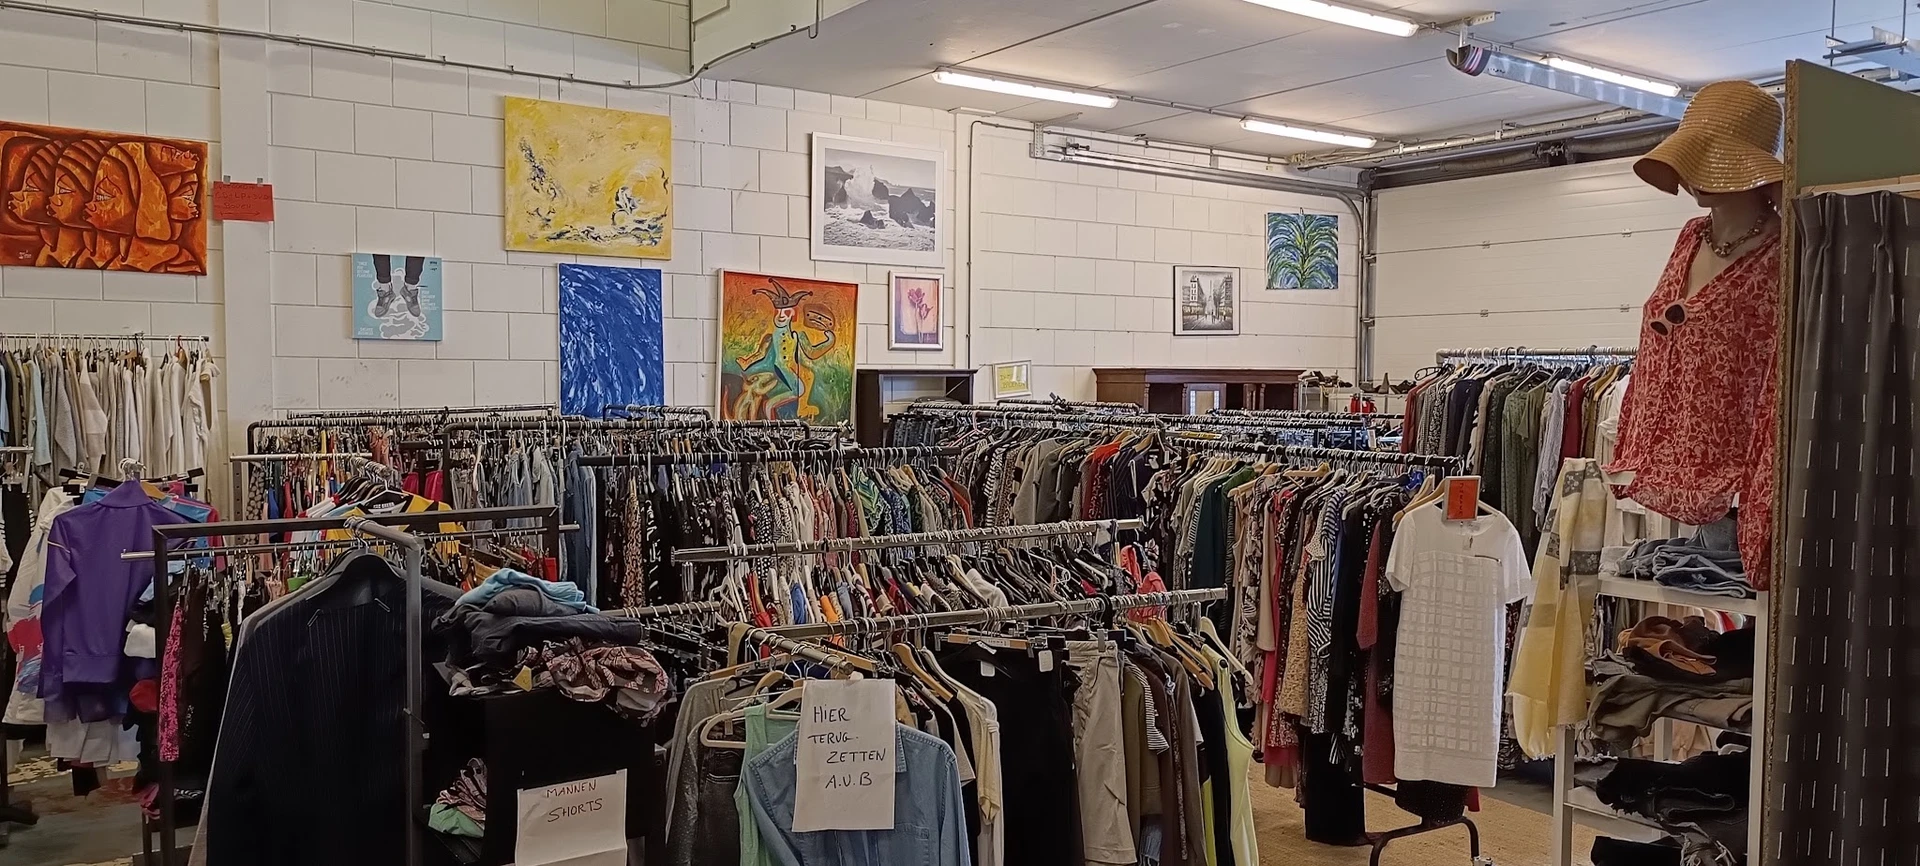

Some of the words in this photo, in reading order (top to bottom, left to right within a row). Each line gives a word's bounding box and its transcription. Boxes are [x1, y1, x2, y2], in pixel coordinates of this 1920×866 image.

[826, 748, 886, 764] ZETTEN
[546, 779, 597, 798] MANNEN
[547, 798, 603, 823] SHORTS
